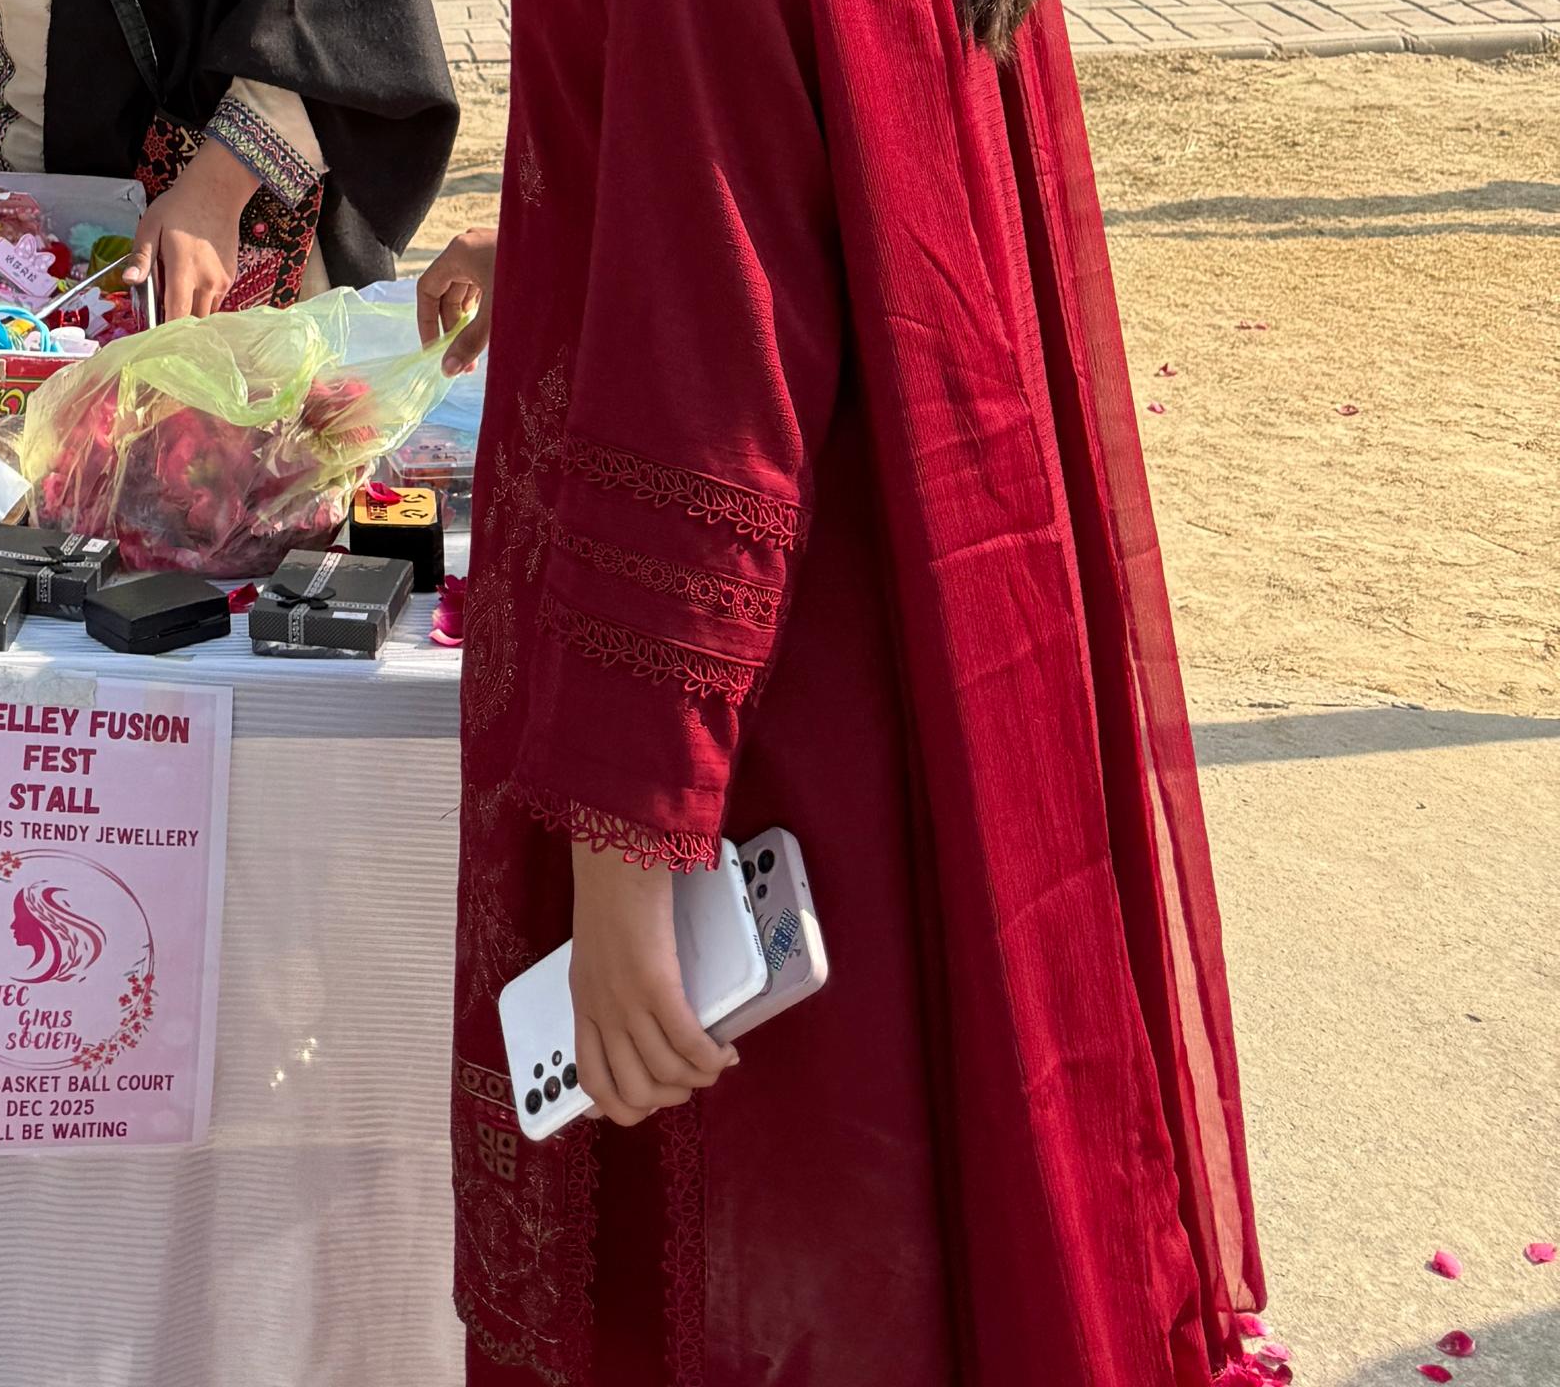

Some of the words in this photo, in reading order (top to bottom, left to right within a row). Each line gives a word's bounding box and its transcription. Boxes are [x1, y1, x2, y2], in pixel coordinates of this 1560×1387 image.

[89, 710, 190, 743] FUSION
[23, 745, 97, 775] FEST
[8, 783, 100, 814] STALL
[20, 821, 89, 842] TRENDY
[95, 826, 200, 848] JEWELLERY
[18, 1010, 73, 1029] GIRLS
[5, 1029, 83, 1053] SOCIETY
[67, 1075, 111, 1093] BALL
[116, 1074, 175, 1092] COURT
[6, 1100, 43, 1117] DEC
[49, 1099, 95, 1116] 2025
[21, 1124, 45, 1141] BE
[52, 1121, 128, 1139] WAITING
